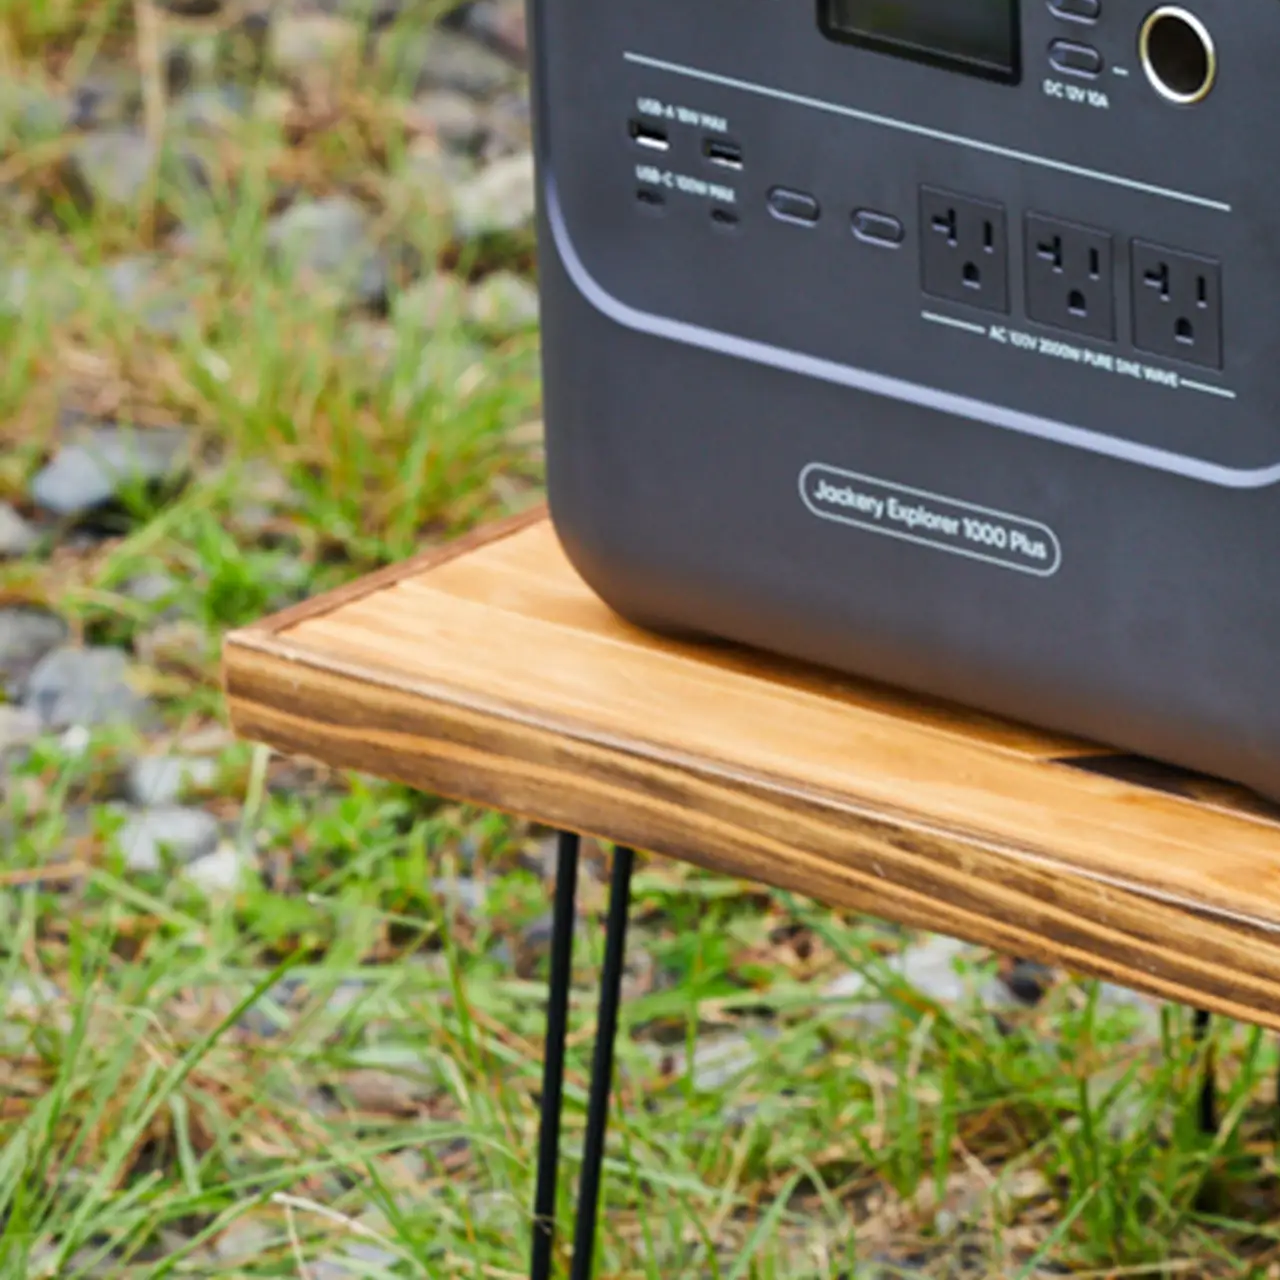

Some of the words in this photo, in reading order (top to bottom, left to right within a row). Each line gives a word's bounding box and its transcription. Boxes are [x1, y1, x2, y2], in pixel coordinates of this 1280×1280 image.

[1043, 79, 1065, 99] DC
[812, 479, 885, 520] Jackery
[886, 497, 960, 535] Explorer
[961, 517, 1008, 549] 1000
[1009, 530, 1048, 560] Plus
